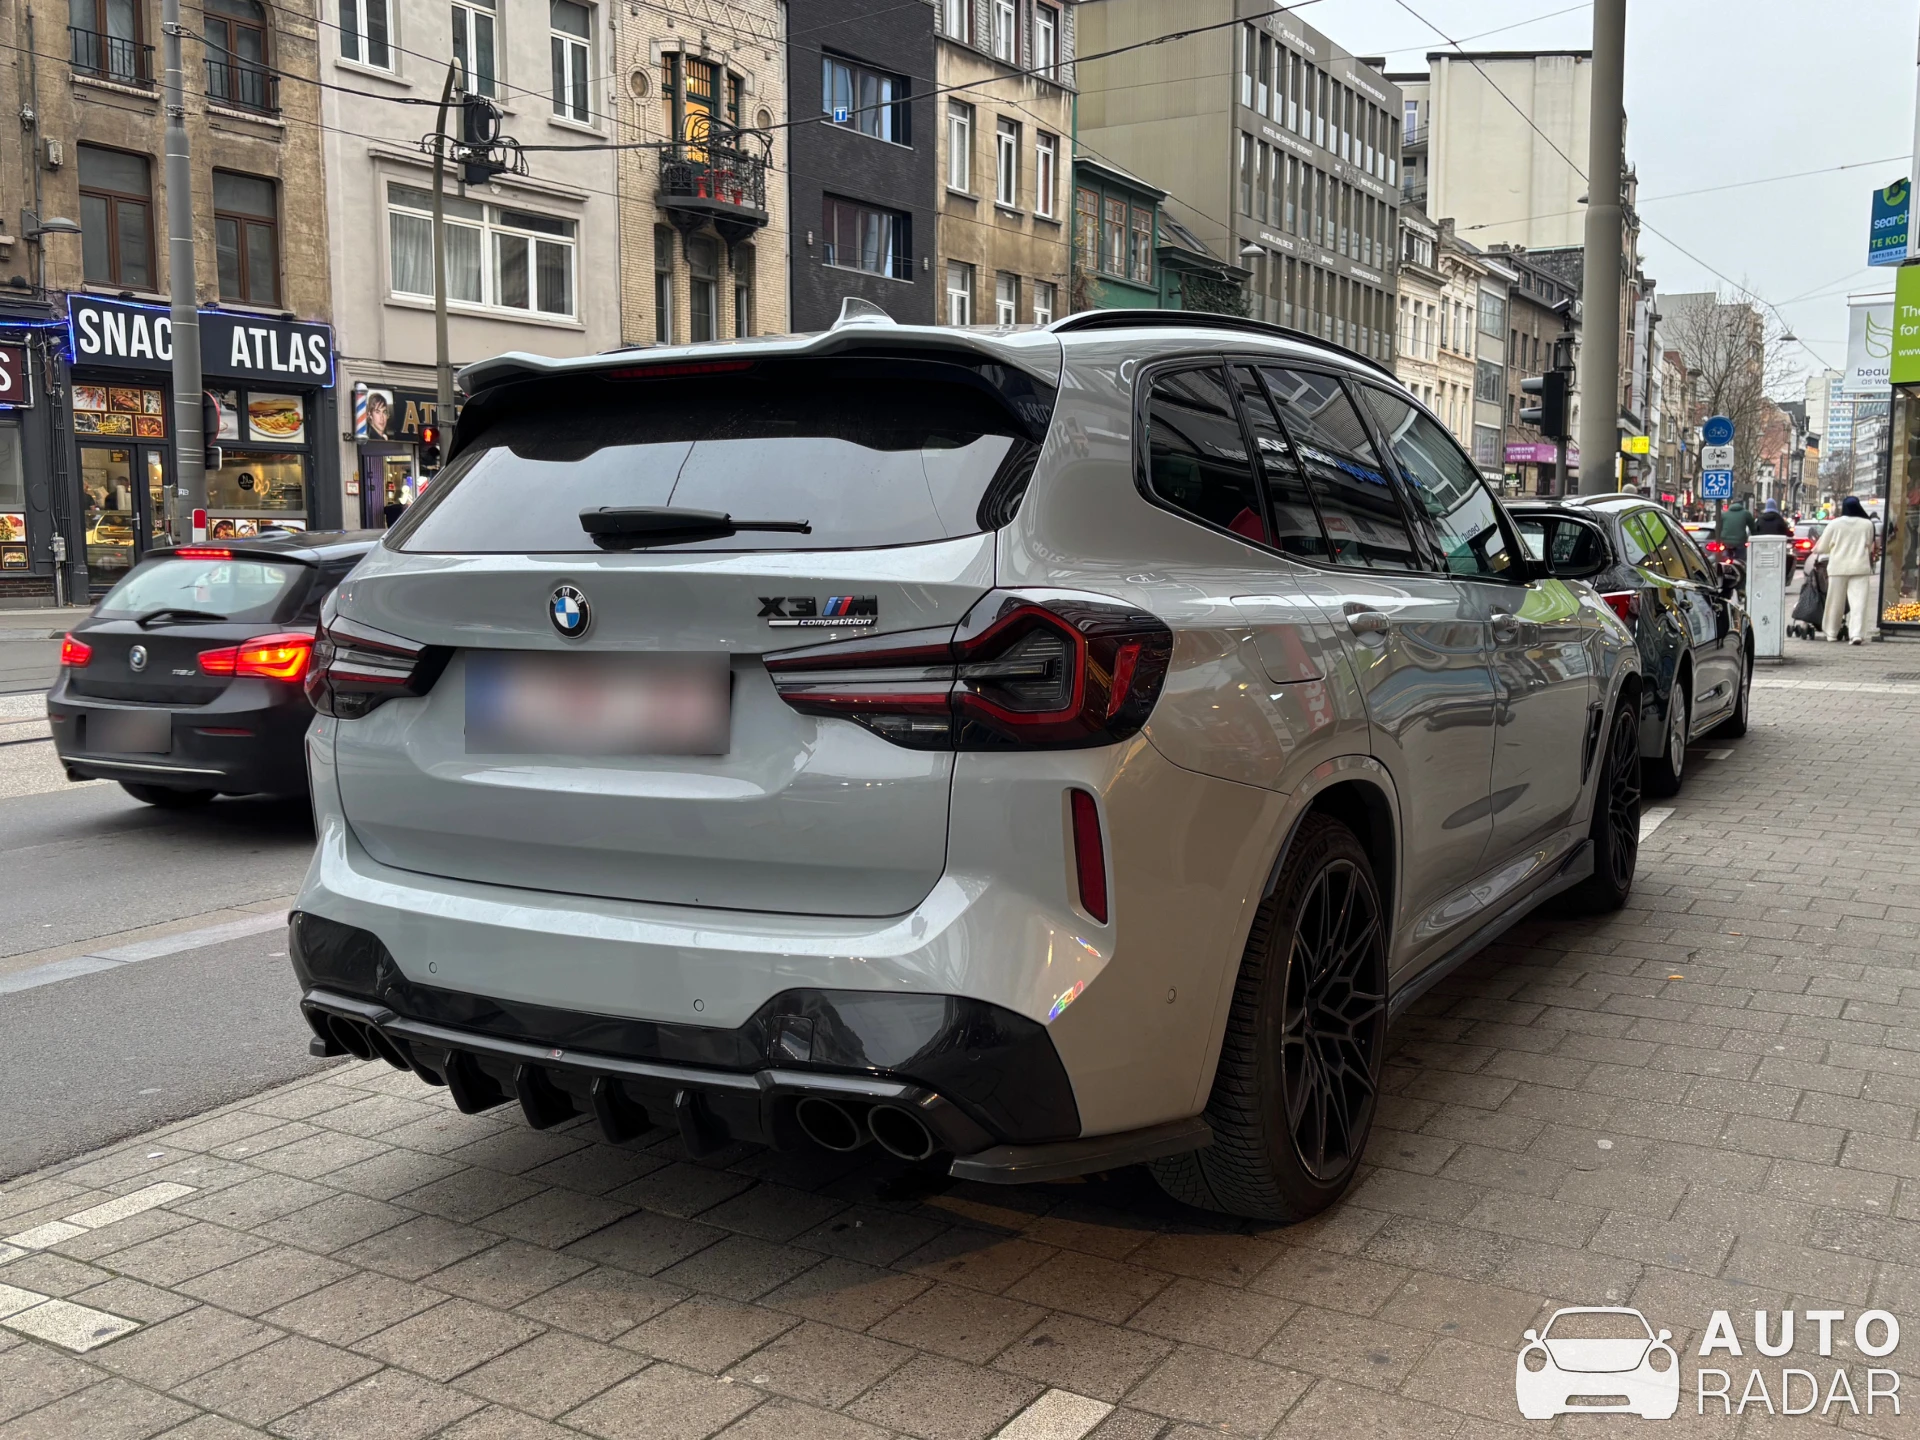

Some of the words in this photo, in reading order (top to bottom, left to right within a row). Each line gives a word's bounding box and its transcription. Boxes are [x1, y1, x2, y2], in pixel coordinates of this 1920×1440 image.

[1872, 239, 1882, 249] TE
[1900, 324, 1919, 336] for
[78, 308, 172, 361] SNAC
[231, 326, 327, 375] ATLAS
[1862, 378, 1873, 386] as
[1707, 474, 1727, 488] 25
[1705, 487, 1728, 495] km/u
[757, 596, 817, 617] X3
[838, 595, 878, 616] M
[799, 618, 872, 627] competition
